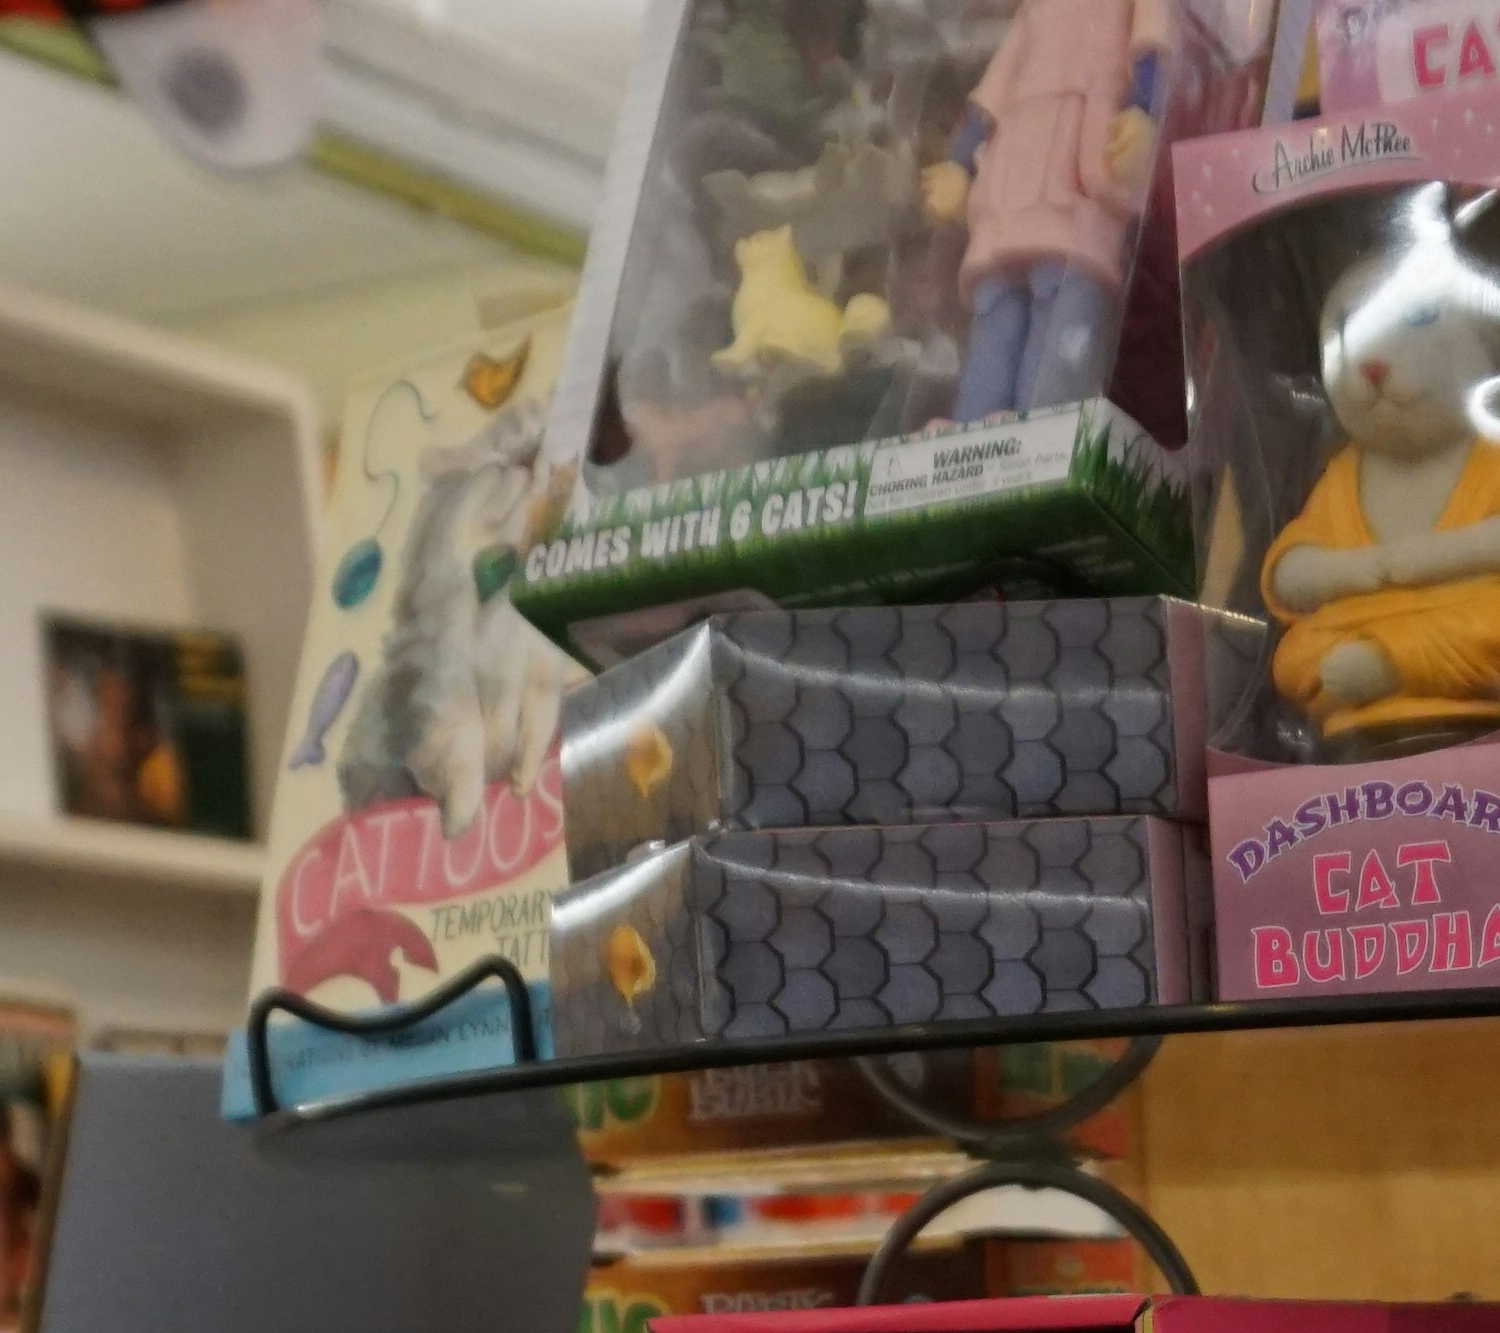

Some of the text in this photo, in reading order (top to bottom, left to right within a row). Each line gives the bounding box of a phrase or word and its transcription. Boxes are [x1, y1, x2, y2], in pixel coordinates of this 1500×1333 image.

[1253, 128, 1336, 193] Archie
[525, 526, 630, 583] COMES
[640, 507, 721, 560] WITH
[729, 501, 752, 541] 6
[761, 479, 858, 534] CATS!
[1311, 839, 1454, 915] CAT
